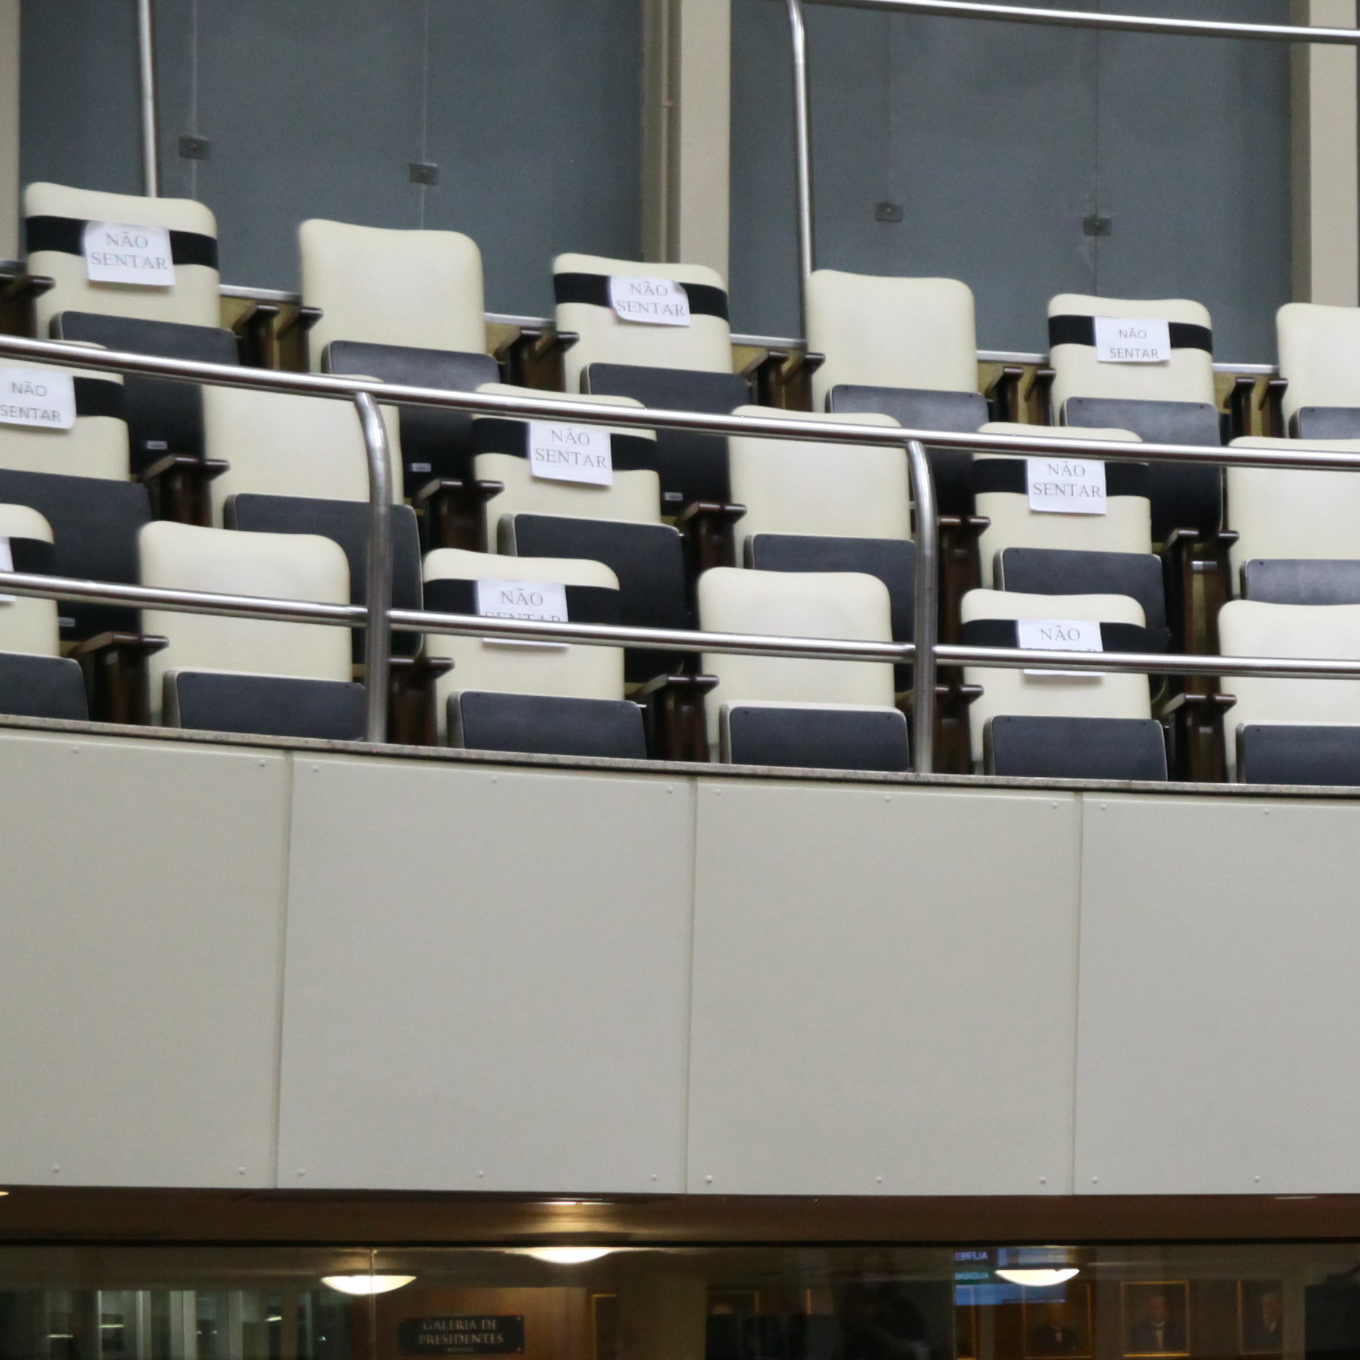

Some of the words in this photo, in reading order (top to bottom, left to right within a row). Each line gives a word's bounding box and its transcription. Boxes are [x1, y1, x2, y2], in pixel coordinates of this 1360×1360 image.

[106, 231, 148, 248] NÃO
[91, 252, 168, 270] SENTAR
[631, 281, 668, 296] NÃO
[617, 300, 685, 316] SENTAR
[1118, 327, 1147, 339] NÃO
[1109, 347, 1158, 359] SENTAR
[11, 381, 47, 397] NÃO
[0, 404, 62, 422] SENTAR
[551, 428, 590, 446] NÃO
[535, 448, 607, 469] SENTAR
[1048, 460, 1086, 477] NÃO
[1033, 482, 1102, 498] SENTAR
[500, 588, 544, 606] NÃO
[1040, 625, 1080, 641] NÃO
[423, 1319, 477, 1331] GALERIA
[482, 1319, 498, 1331] DE
[419, 1332, 504, 1345] PRESIDENTES
